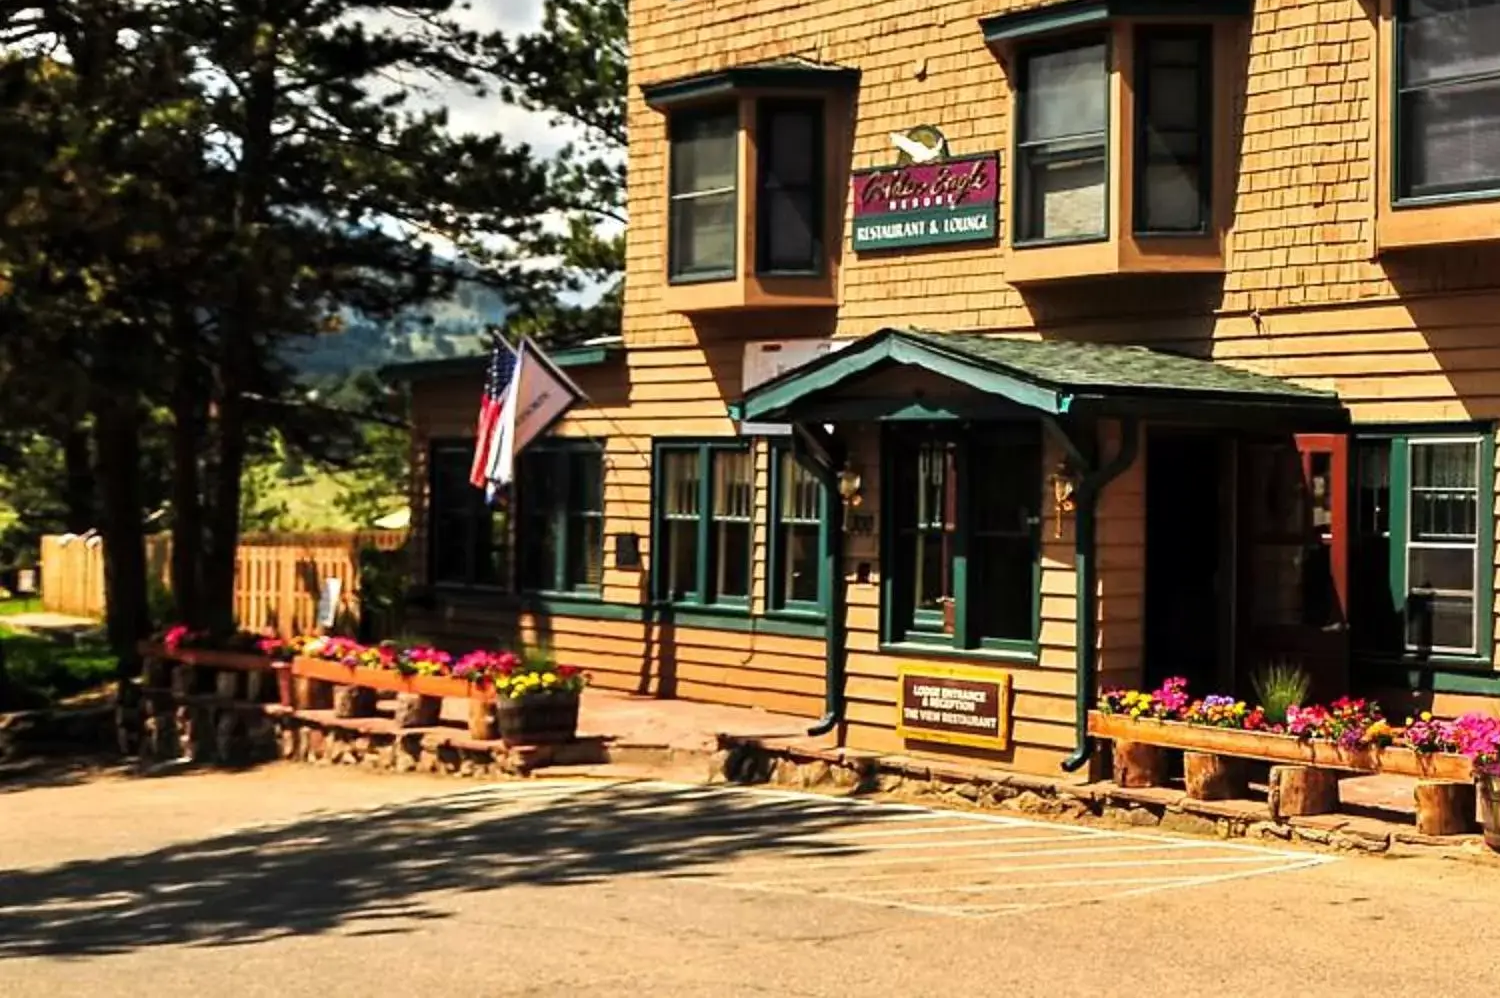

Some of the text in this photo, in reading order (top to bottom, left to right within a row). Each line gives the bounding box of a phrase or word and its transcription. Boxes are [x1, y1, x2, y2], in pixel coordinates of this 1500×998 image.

[857, 214, 988, 241] RESTAURANT & LOUNGE
[929, 698, 975, 711] RECEPTION
[942, 712, 996, 728] RESTAURANT
